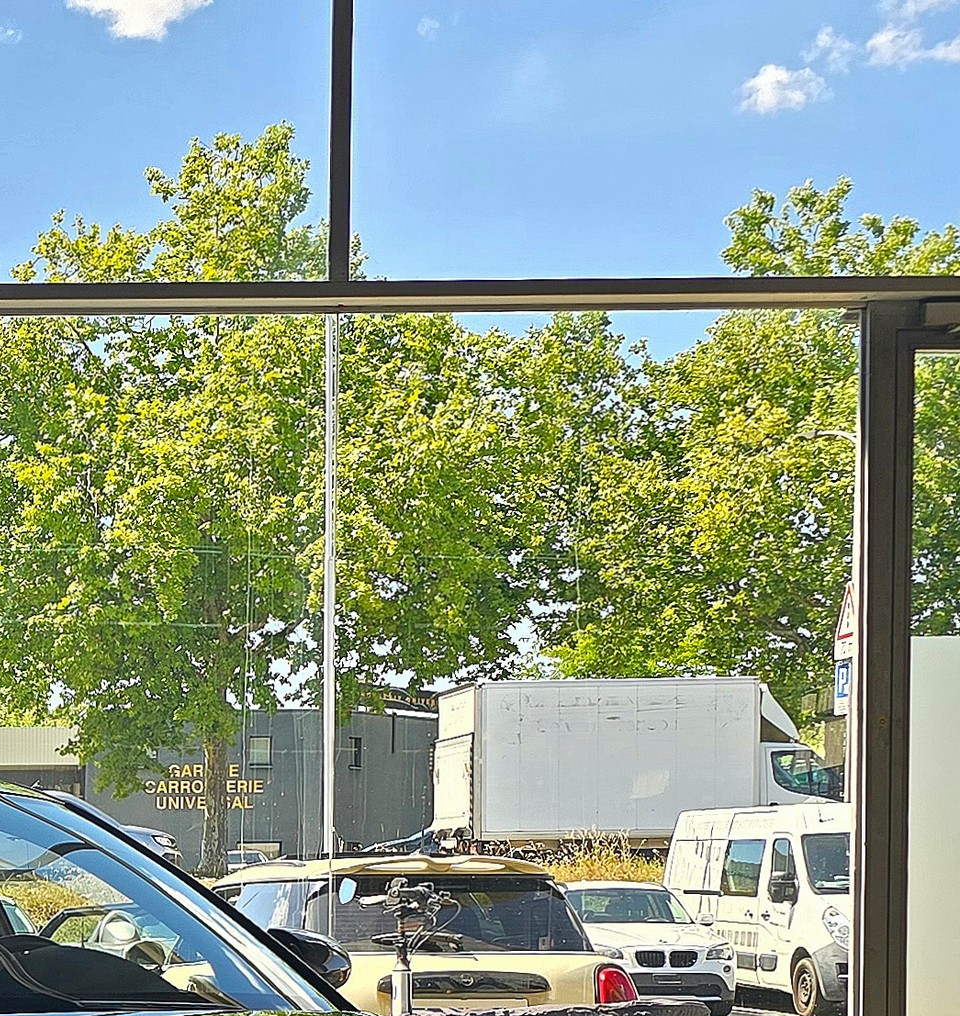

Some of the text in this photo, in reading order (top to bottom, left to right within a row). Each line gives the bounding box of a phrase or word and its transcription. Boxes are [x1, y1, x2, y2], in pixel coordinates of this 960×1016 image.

[168, 764, 239, 778] GARE
[145, 780, 264, 794] CARROERIE
[156, 796, 254, 810] UNIVEAL
